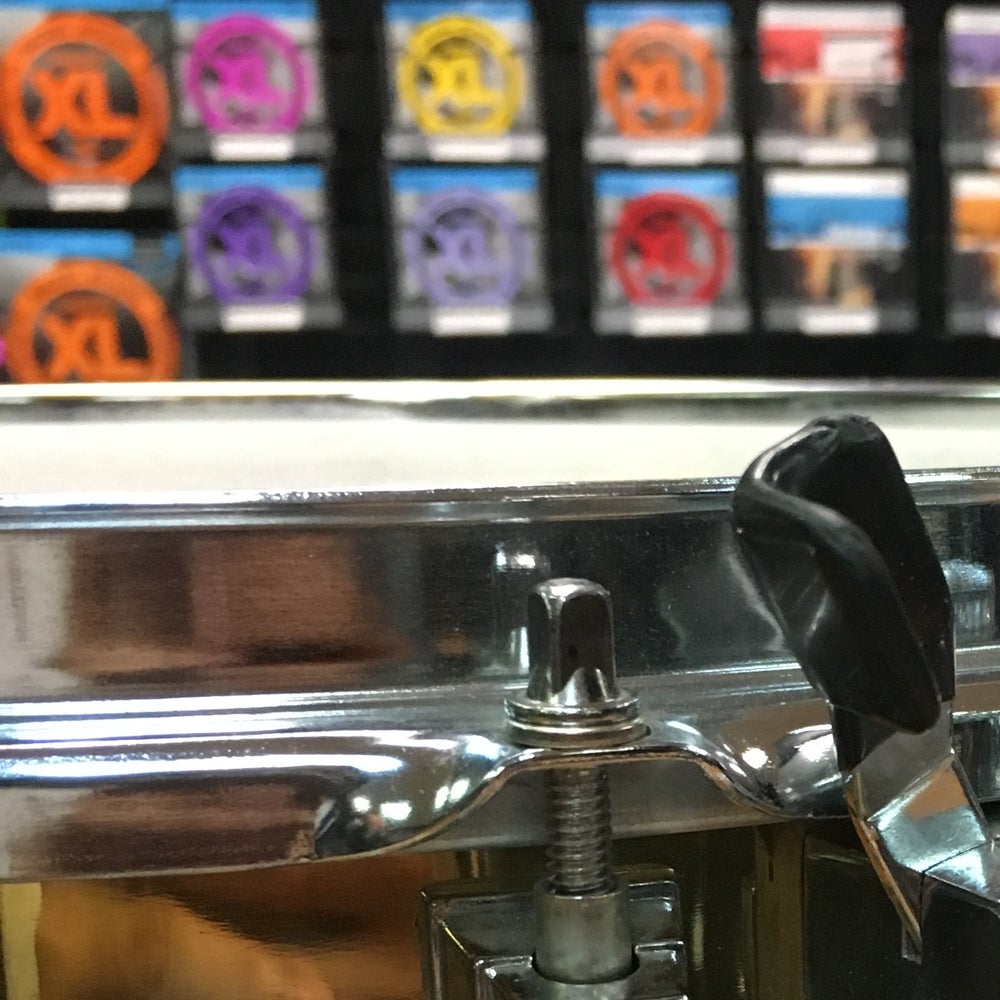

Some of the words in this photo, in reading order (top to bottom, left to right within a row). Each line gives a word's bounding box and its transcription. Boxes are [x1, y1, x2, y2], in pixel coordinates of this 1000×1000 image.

[30, 70, 136, 138] XL
[421, 56, 502, 107] XL
[42, 317, 152, 382] XL
